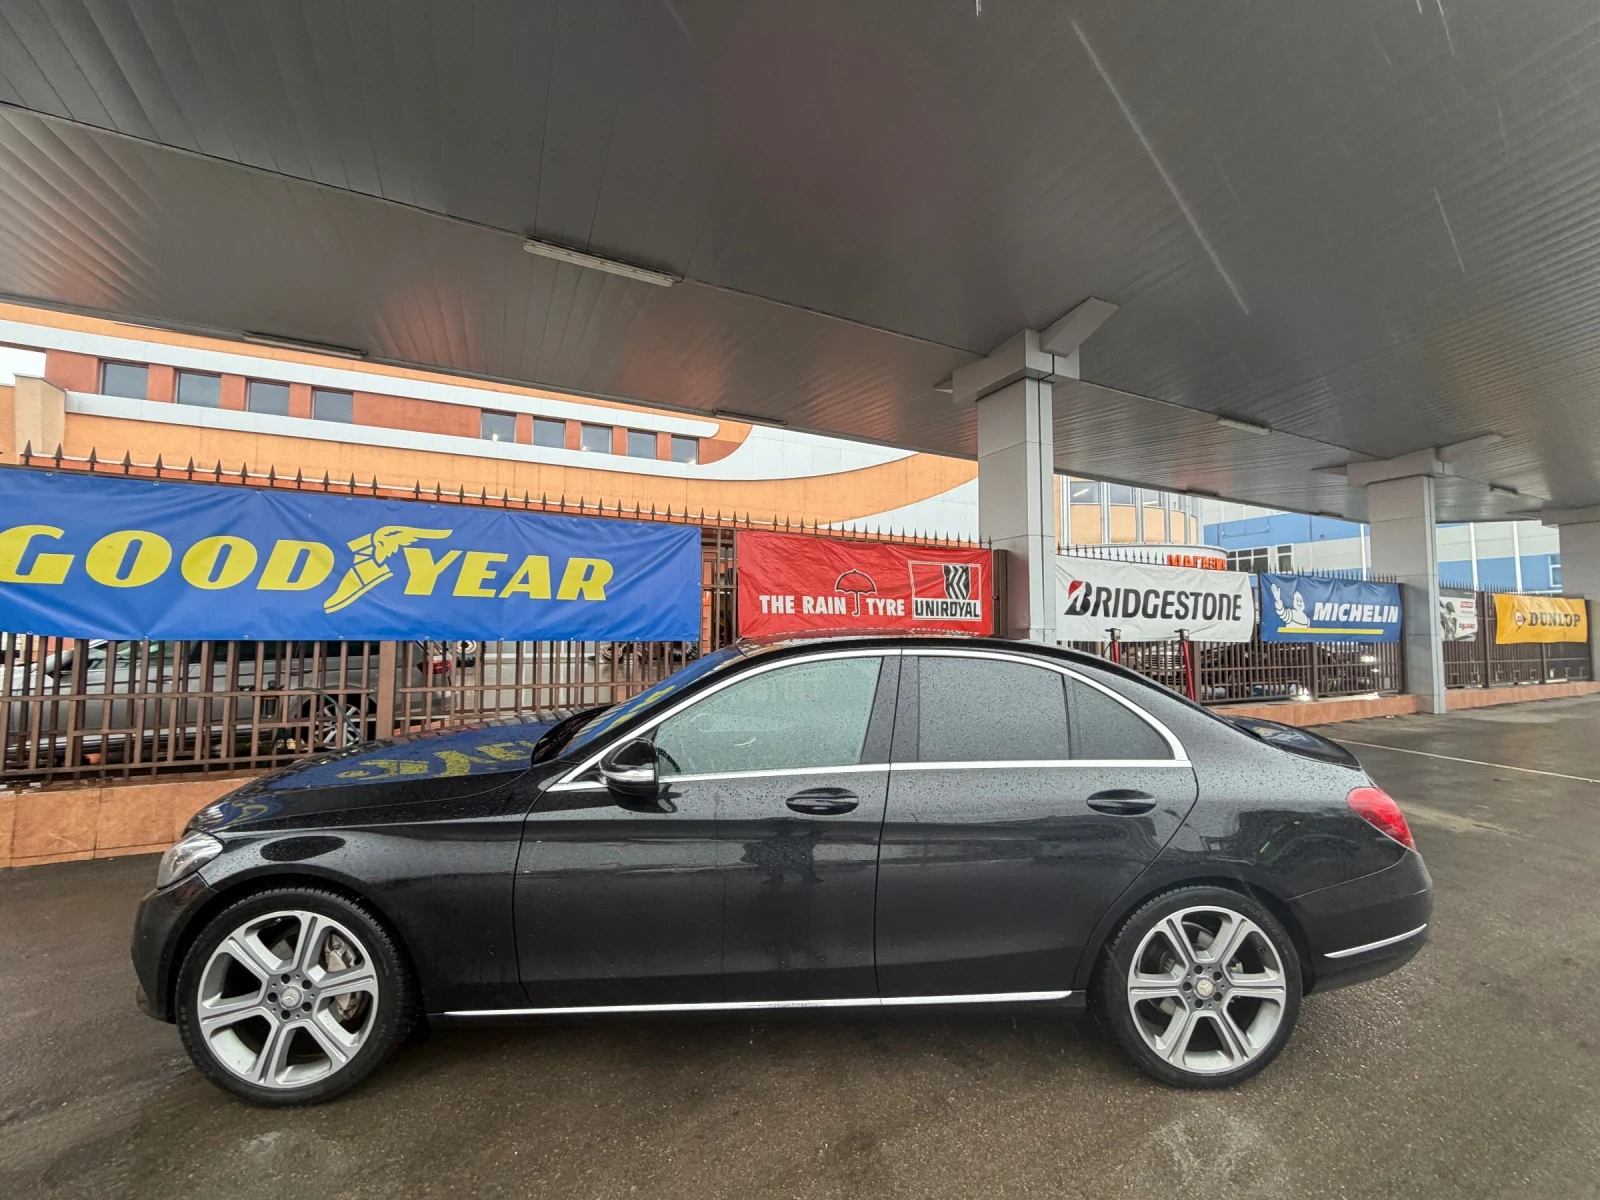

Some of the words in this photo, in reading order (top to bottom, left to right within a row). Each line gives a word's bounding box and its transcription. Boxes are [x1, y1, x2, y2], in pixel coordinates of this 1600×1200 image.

[759, 595, 795, 614] THE
[802, 596, 847, 615] RAIN
[866, 598, 905, 616] TYRE
[914, 600, 980, 618] UNIROYAL
[1064, 580, 1242, 622] BRIDGESTONE
[1313, 602, 1399, 623] MICHELIN
[1528, 612, 1580, 628] DUNLOP
